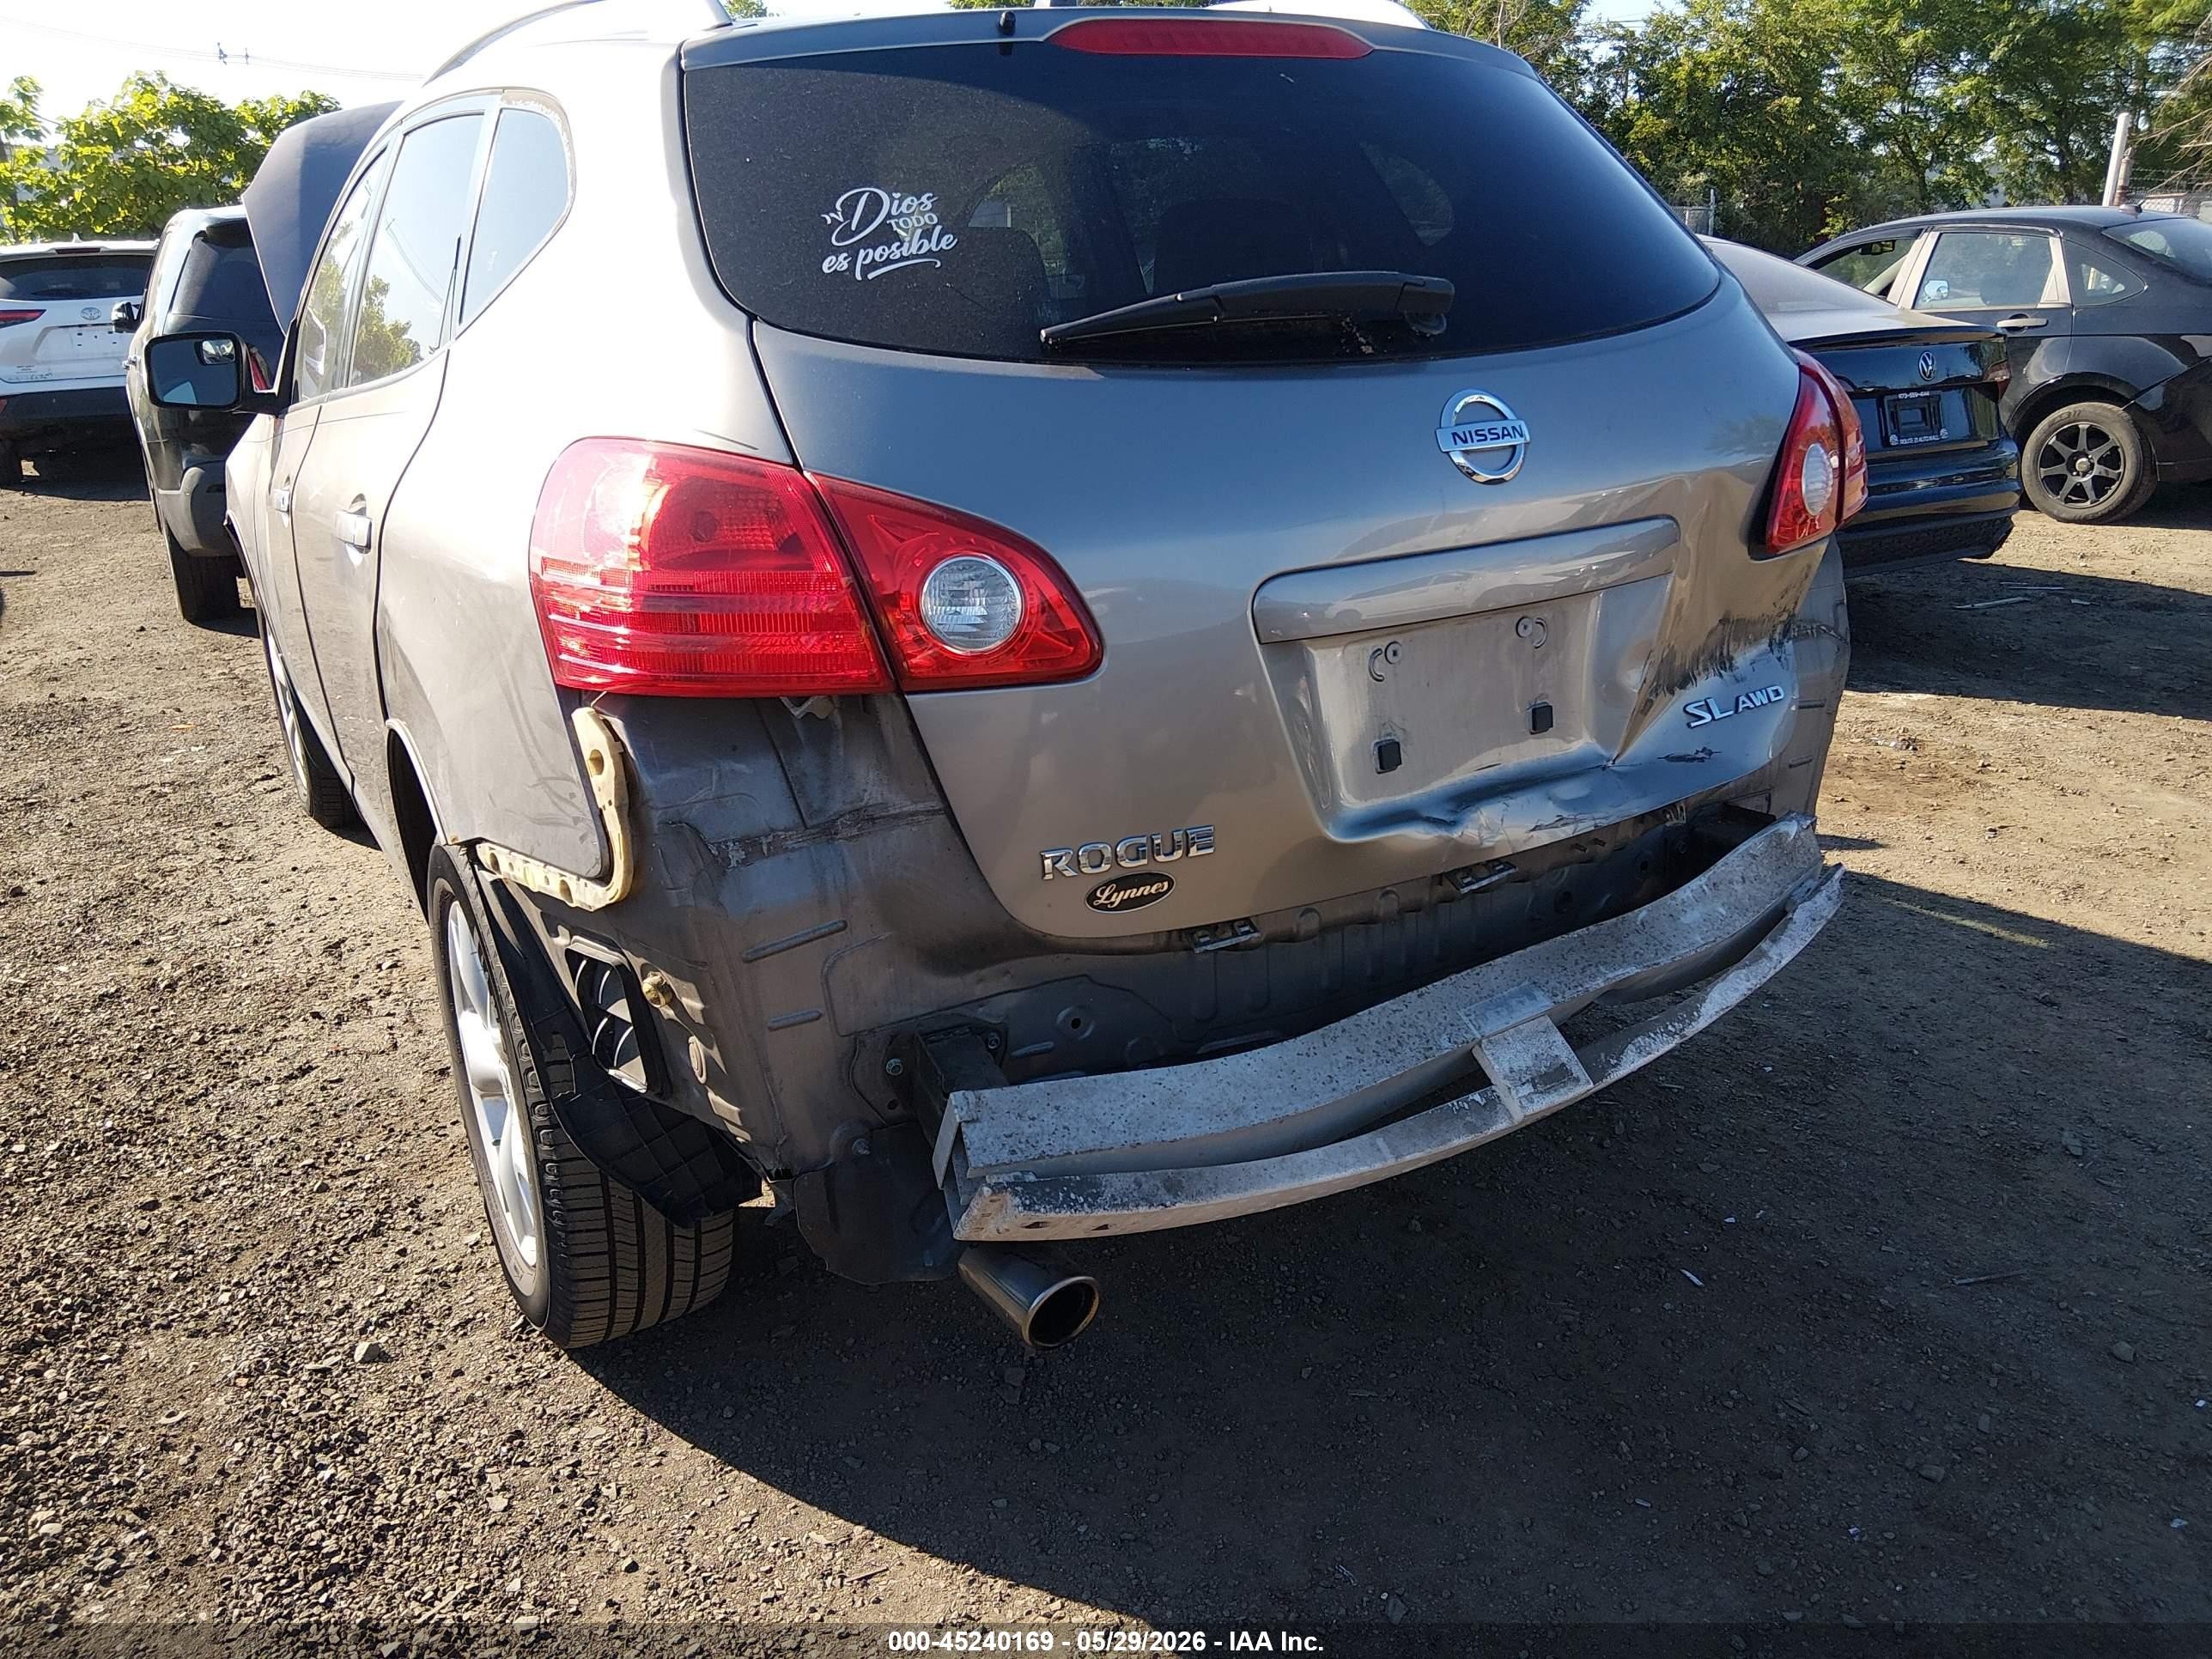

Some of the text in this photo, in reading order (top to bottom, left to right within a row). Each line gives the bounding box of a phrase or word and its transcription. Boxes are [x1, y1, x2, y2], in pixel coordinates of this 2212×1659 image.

[831, 187, 939, 246] Dios
[886, 213, 939, 231] TODO
[822, 225, 958, 281] es posible
[1451, 425, 1523, 445] NISSAN
[1683, 685, 1785, 729] SL AWD
[1040, 824, 1214, 880] ROGUE
[1092, 879, 1170, 908] Lynnes
